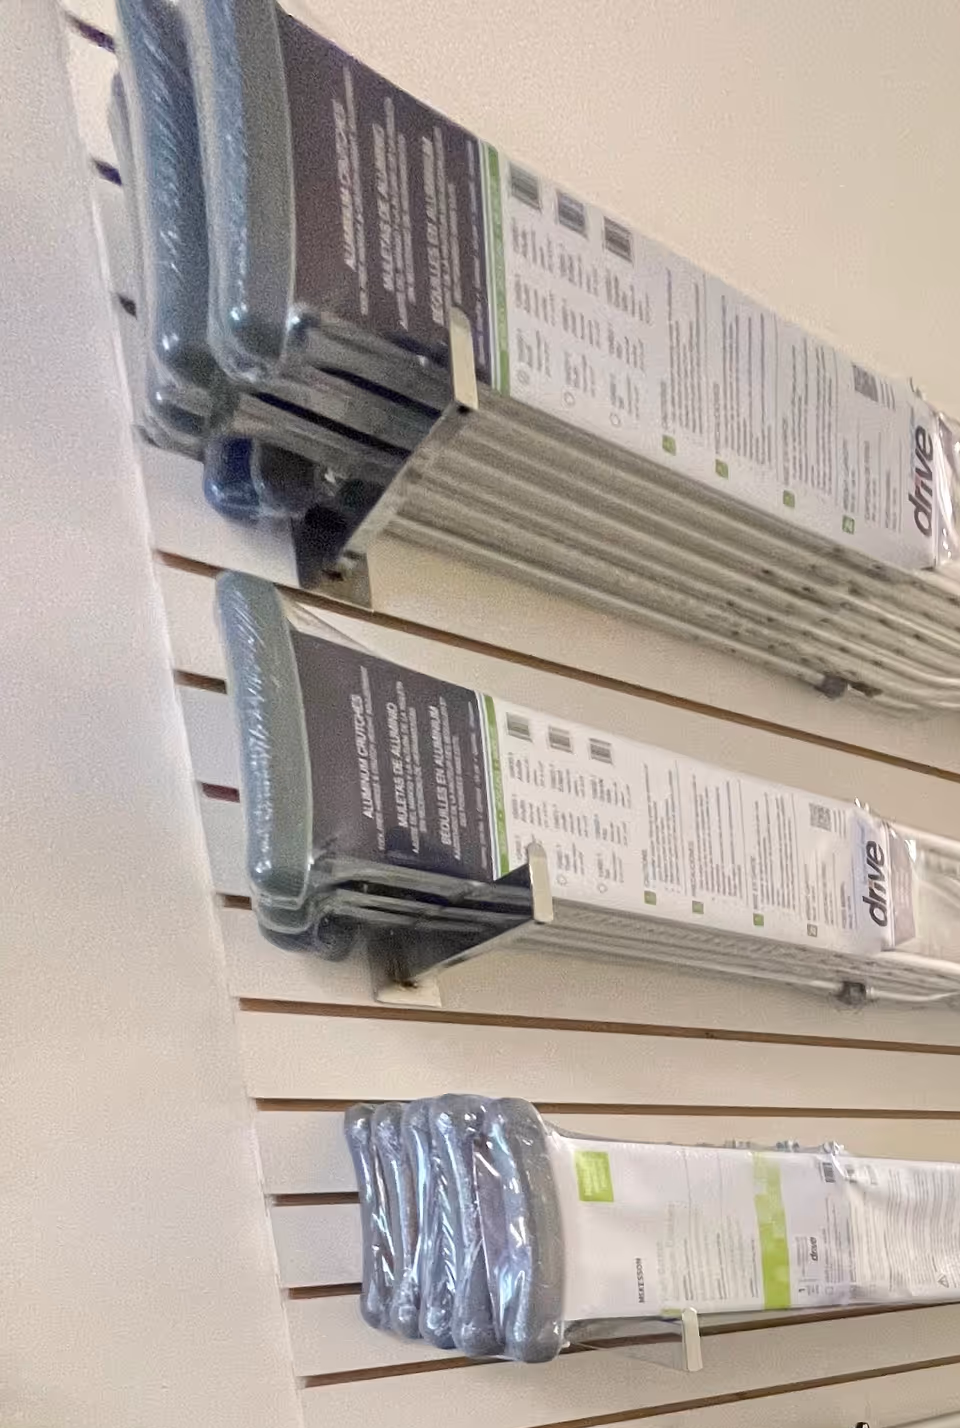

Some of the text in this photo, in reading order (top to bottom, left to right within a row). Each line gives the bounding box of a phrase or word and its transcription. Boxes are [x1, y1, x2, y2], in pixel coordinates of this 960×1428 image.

[908, 425, 933, 537] drive
[351, 694, 367, 755] CRUTCHES
[359, 757, 374, 819] ALUMINUM
[386, 702, 408, 827] MULETAS DE ALUMINIO
[436, 768, 446, 783] EN
[862, 841, 889, 927] drive
[809, 1236, 819, 1262] drive
